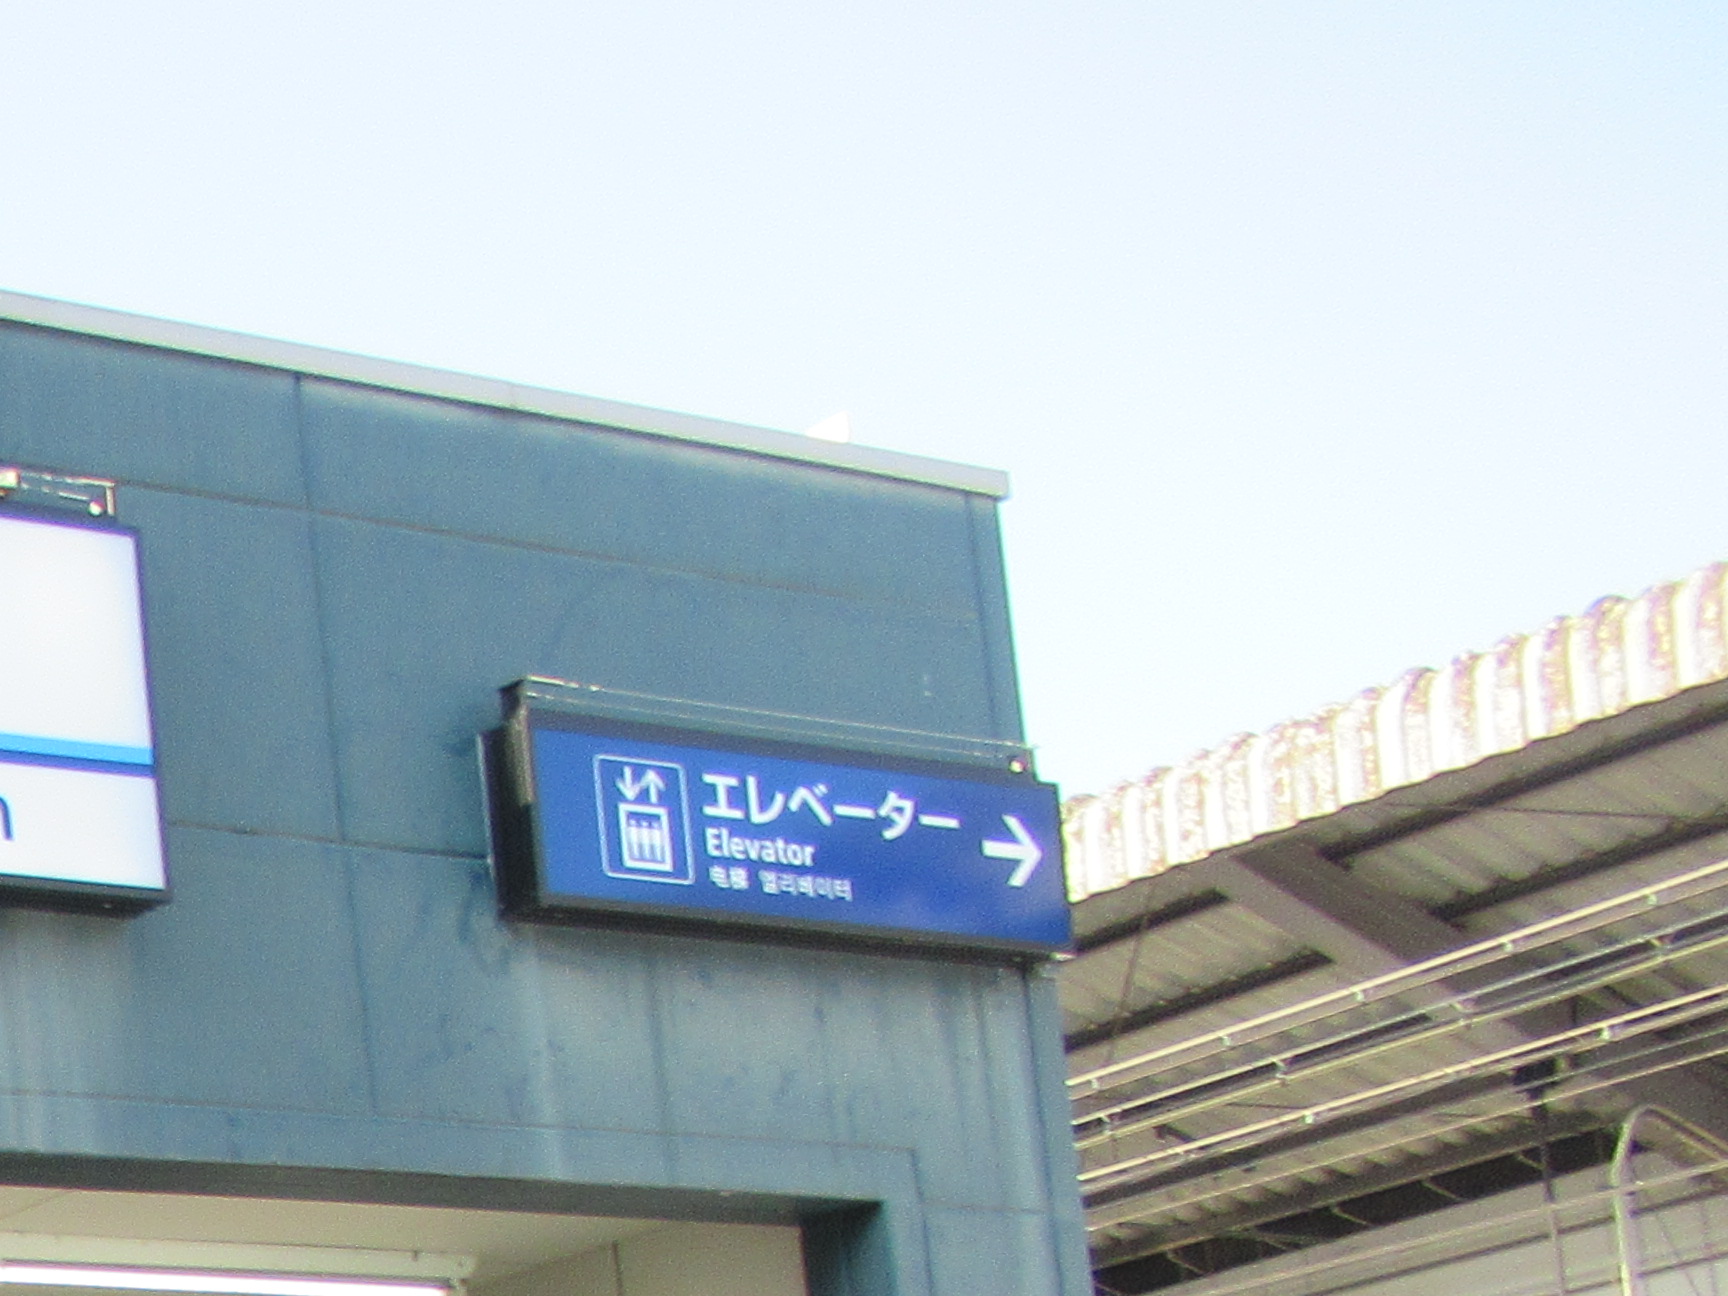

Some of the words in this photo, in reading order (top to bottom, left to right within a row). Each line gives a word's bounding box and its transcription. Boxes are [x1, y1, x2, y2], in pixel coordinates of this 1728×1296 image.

[701, 772, 961, 840] エレベーター
[704, 827, 815, 867] Elevator
